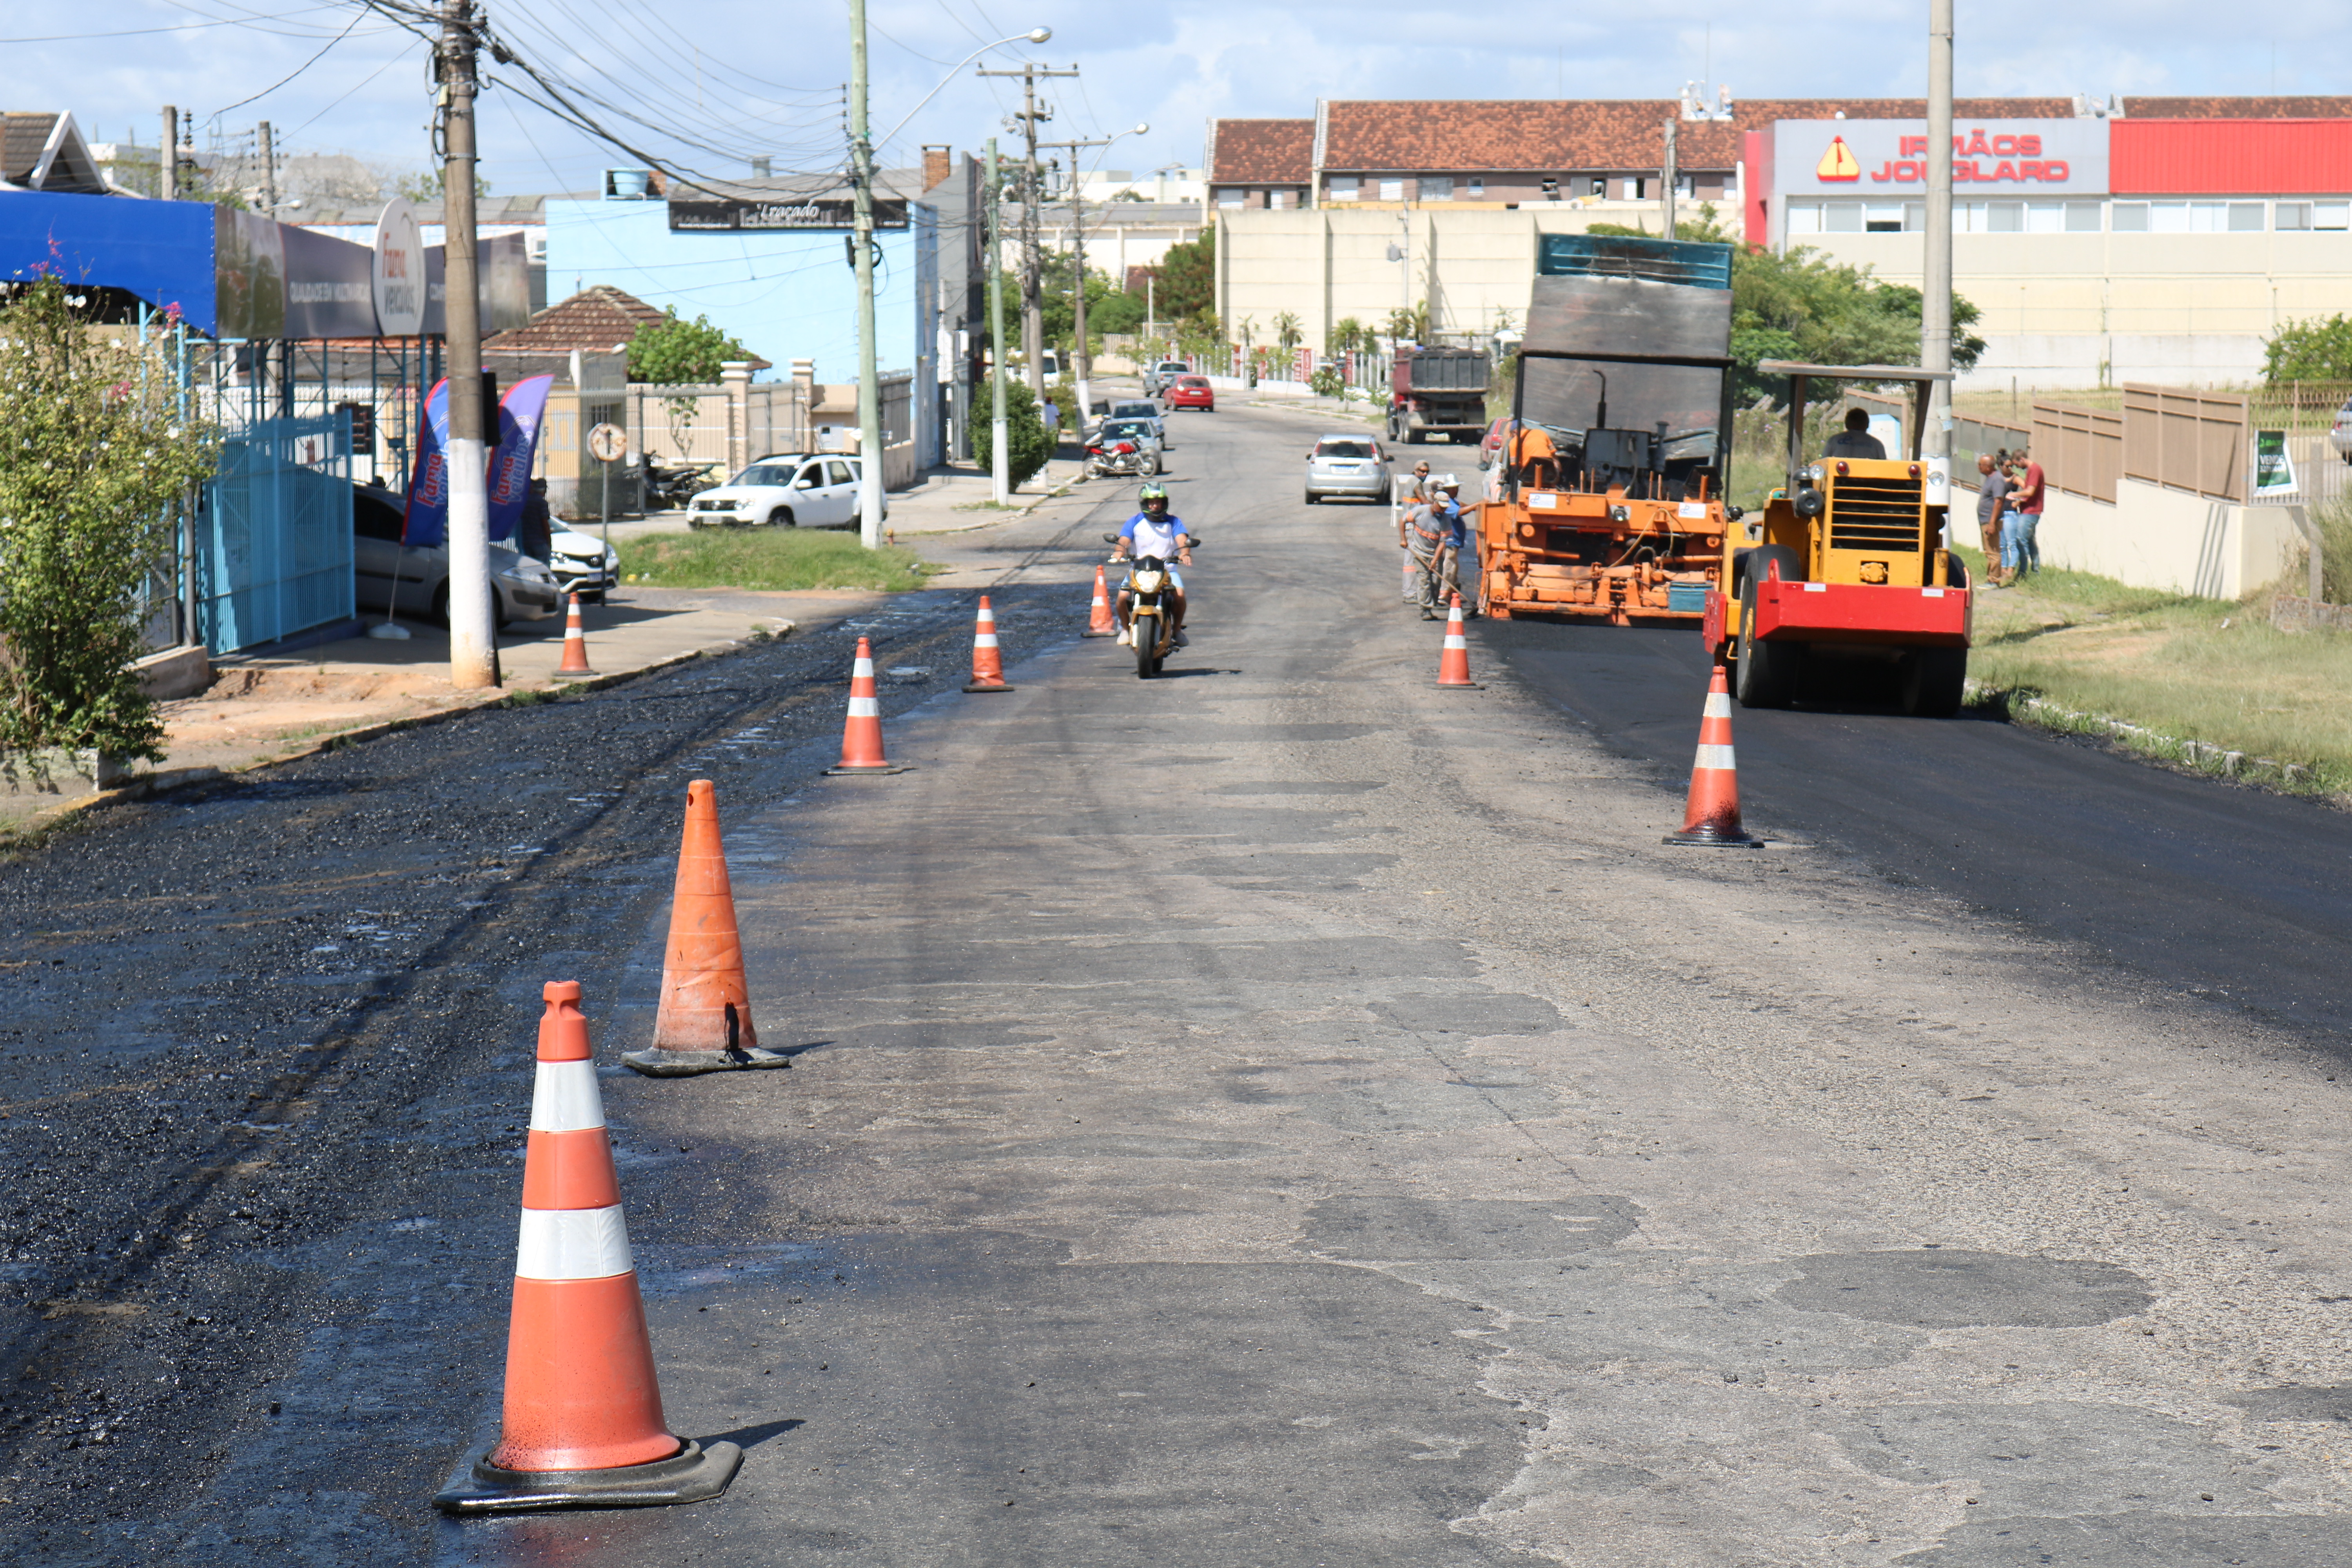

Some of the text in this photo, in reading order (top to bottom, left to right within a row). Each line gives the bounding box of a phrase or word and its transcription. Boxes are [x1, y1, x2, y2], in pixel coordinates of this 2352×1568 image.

[382, 232, 406, 278] Fama
[415, 453, 443, 507] Fama
[490, 456, 515, 505] Fama
